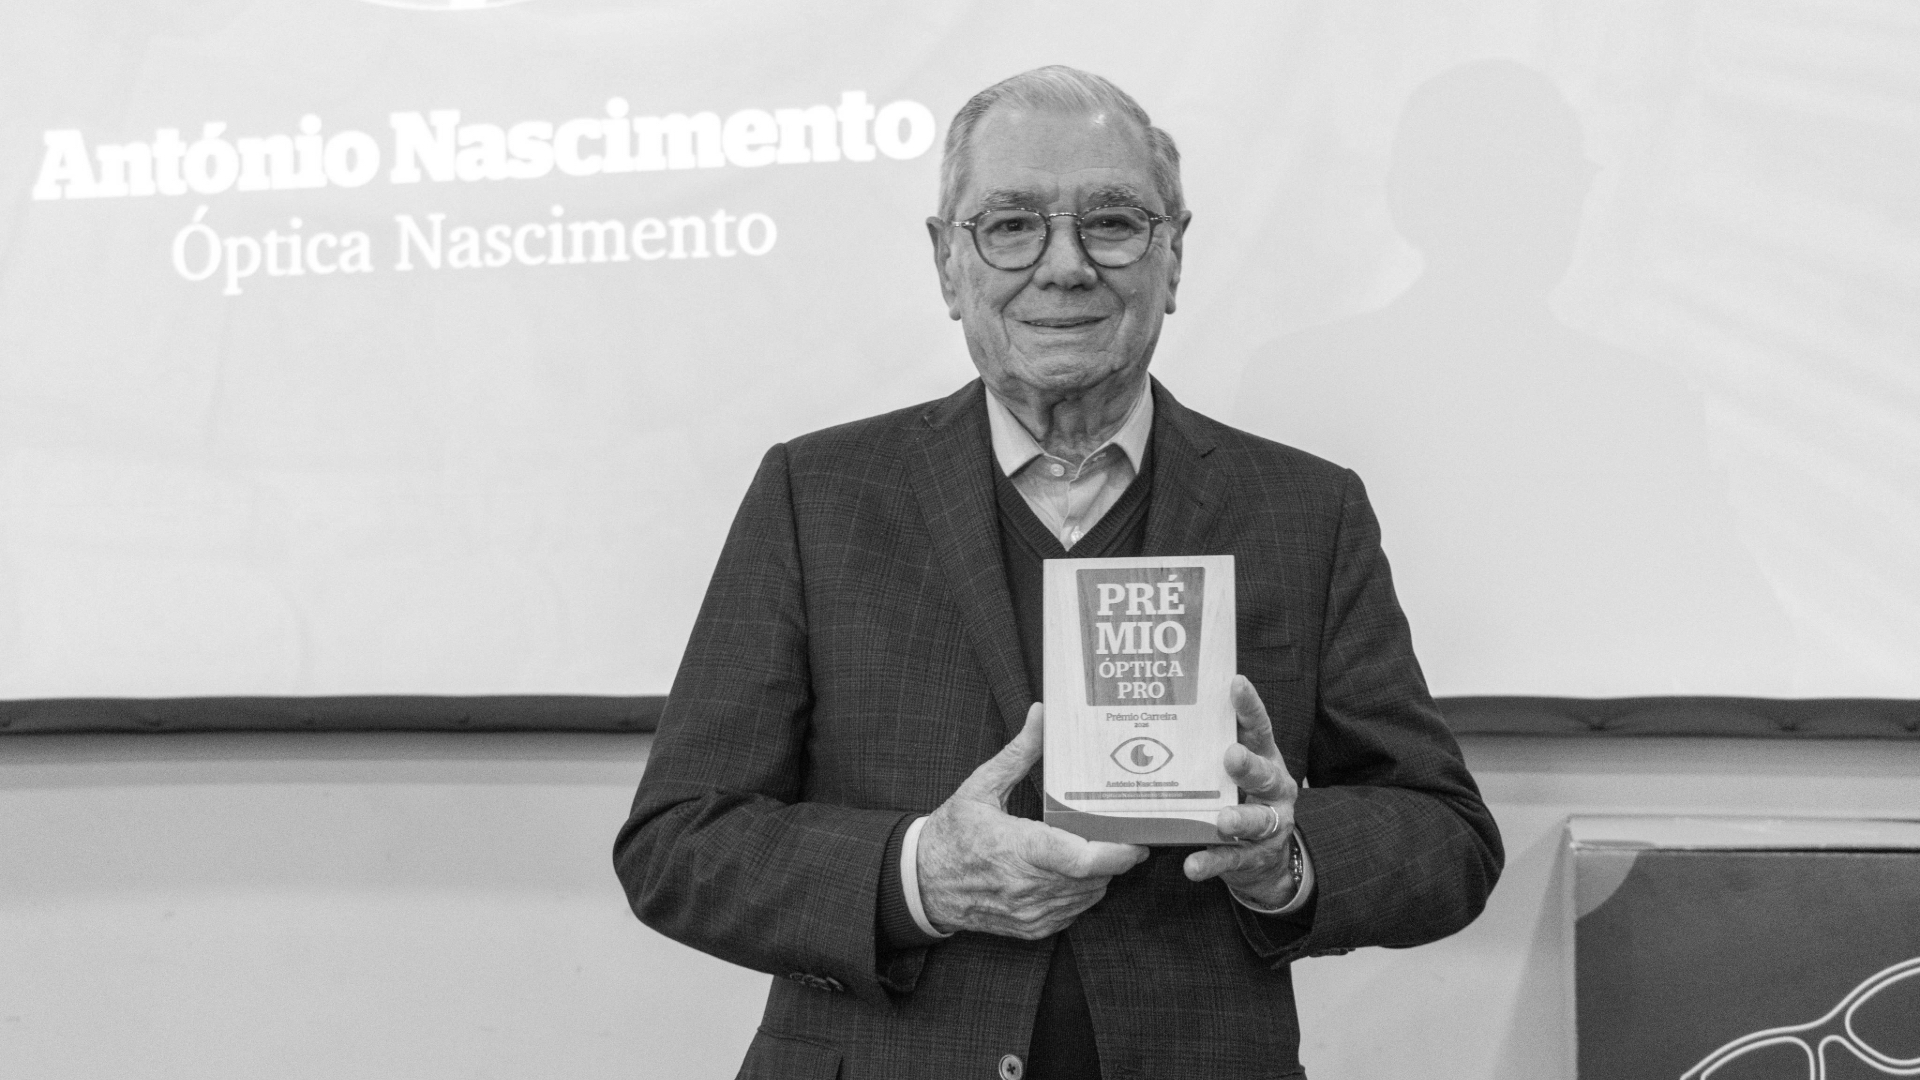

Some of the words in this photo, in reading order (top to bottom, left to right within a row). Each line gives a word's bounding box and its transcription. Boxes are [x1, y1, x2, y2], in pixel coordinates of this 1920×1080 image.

[32, 112, 381, 200] António
[390, 89, 936, 184] Nascimento
[171, 204, 375, 296] Óptica
[394, 204, 778, 271] Nascimento
[1096, 574, 1185, 616] PRÉ
[1095, 620, 1187, 655] MIO
[1099, 657, 1185, 679] ÓPTICA
[1117, 681, 1166, 699] PRO
[1106, 712, 1139, 722] Prémio
[1140, 712, 1178, 721] Carreira
[1105, 780, 1136, 788] António
[1136, 780, 1180, 788] Nascimento
